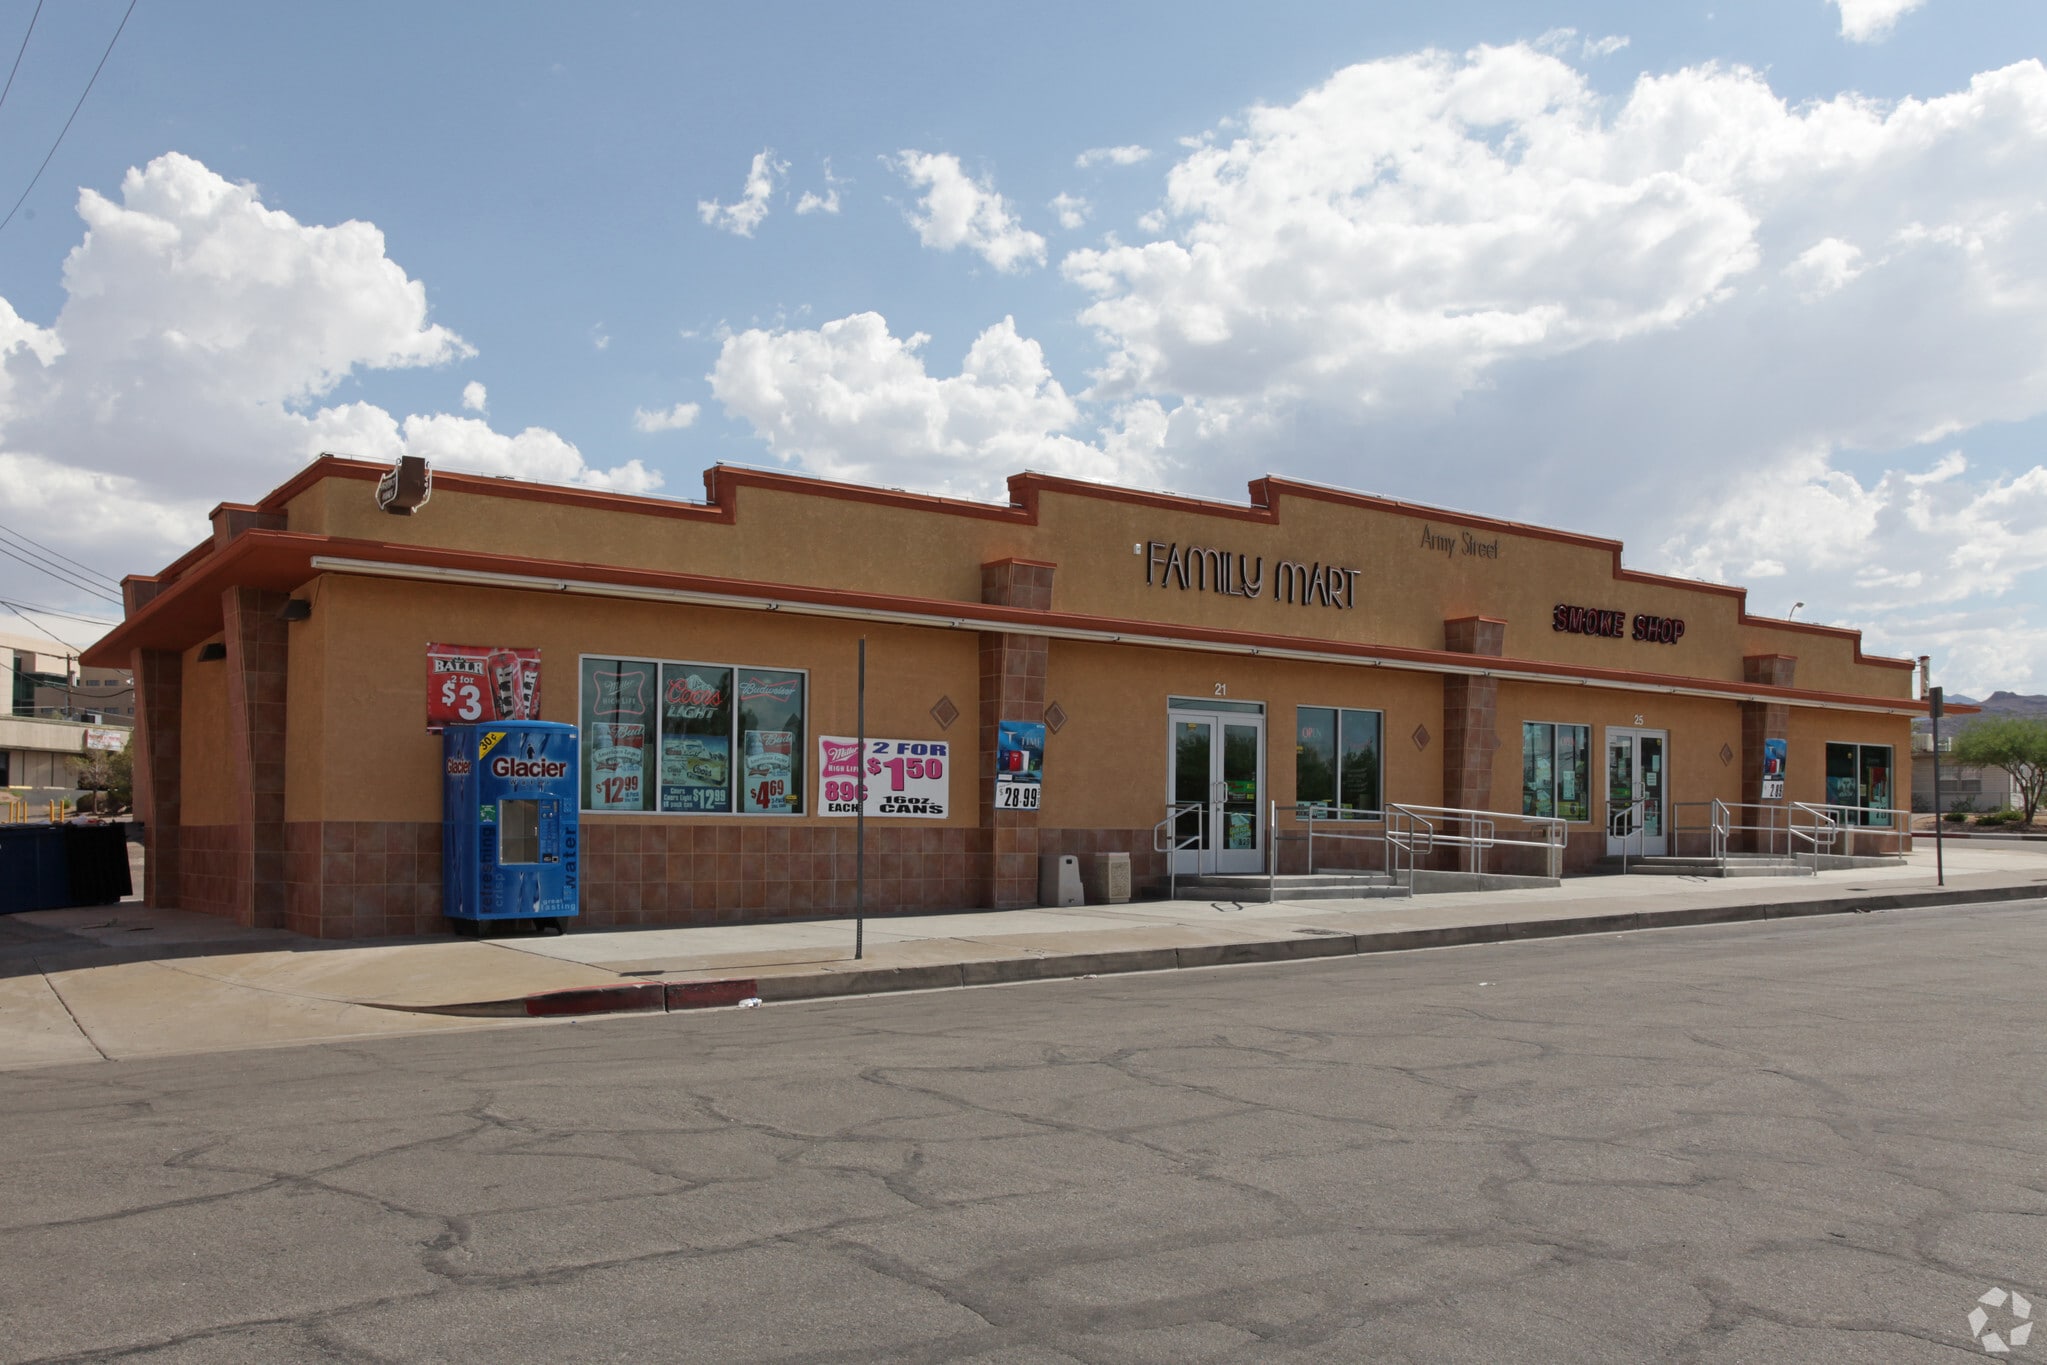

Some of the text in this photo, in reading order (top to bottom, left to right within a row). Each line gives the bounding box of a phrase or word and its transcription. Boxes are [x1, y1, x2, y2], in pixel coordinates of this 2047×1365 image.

[1421, 523, 1498, 559] Army Street
[1147, 541, 1361, 609] FAMILY MART
[1552, 604, 1685, 644] SMOKE SHOP
[434, 660, 484, 675] BALLR
[451, 675, 475, 684] 2 for
[666, 678, 721, 707] Coors
[1214, 683, 1227, 696] 21
[666, 705, 718, 719] LIGHT
[1634, 714, 1644, 725] 25
[872, 742, 947, 756] 2 FOR
[447, 757, 471, 775] Glacier
[492, 757, 567, 778] Glacier
[846, 764, 860, 772] LIF
[828, 803, 860, 813] EACH
[879, 804, 943, 814] CANS
[563, 827, 577, 889] water
[480, 826, 496, 913] refreshing
[495, 873, 506, 908] crisp
[541, 902, 576, 912] tasting
